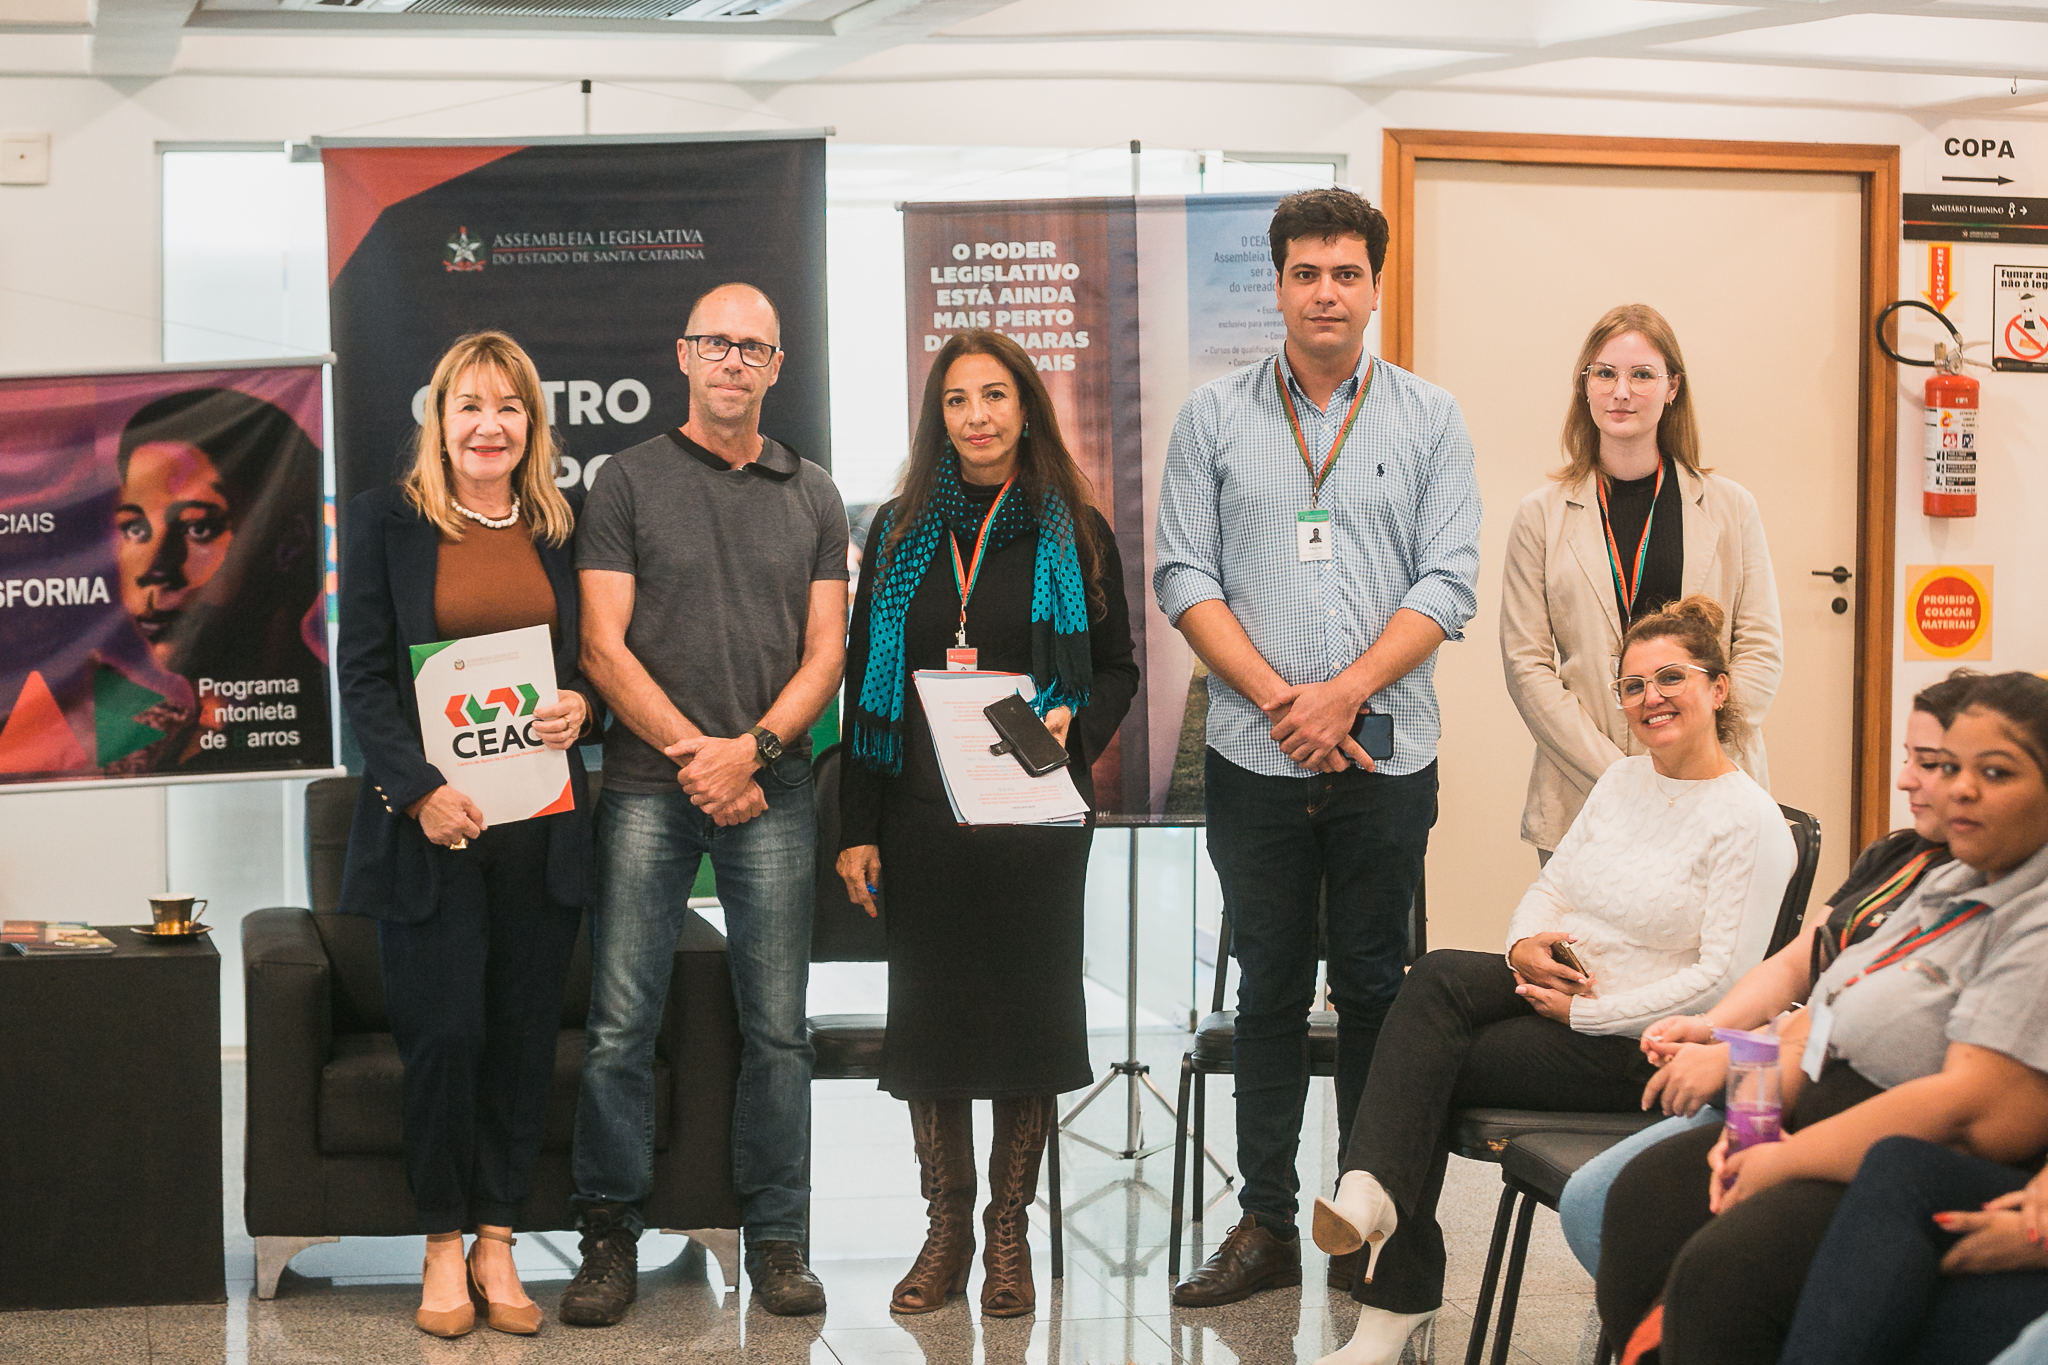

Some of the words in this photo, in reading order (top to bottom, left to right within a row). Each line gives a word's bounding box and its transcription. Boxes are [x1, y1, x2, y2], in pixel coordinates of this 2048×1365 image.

[1944, 138, 2015, 159] COPA
[493, 232, 595, 247] ASSEMBLEIA
[600, 229, 704, 245] LEGISLATIVA
[492, 253, 514, 266] DO
[518, 252, 569, 265] ESTADO
[572, 251, 589, 263] DE
[594, 250, 636, 262] SANTA
[638, 249, 705, 261] CATARINA
[952, 244, 971, 261] O
[975, 241, 1057, 260] PODER
[1214, 251, 1265, 263] Assembleia
[931, 263, 1080, 284] LEGISLATIVO
[2001, 269, 2033, 279] Fumar
[2001, 279, 2021, 288] não
[937, 284, 995, 306] ESTÁ
[998, 286, 1076, 303] AINDA
[934, 311, 991, 329] MAIS
[996, 309, 1074, 327] PERTO
[994, 329, 1090, 350] MARAS
[0, 576, 110, 608] FORMA
[1923, 594, 1975, 605] PROIBIDO
[1925, 607, 1973, 617] COLOCAR
[1921, 619, 1976, 630] MATERIAIS
[199, 678, 300, 700] Programa
[213, 701, 297, 723] ntonieta
[200, 729, 227, 749] de
[452, 718, 545, 759] CEAC
